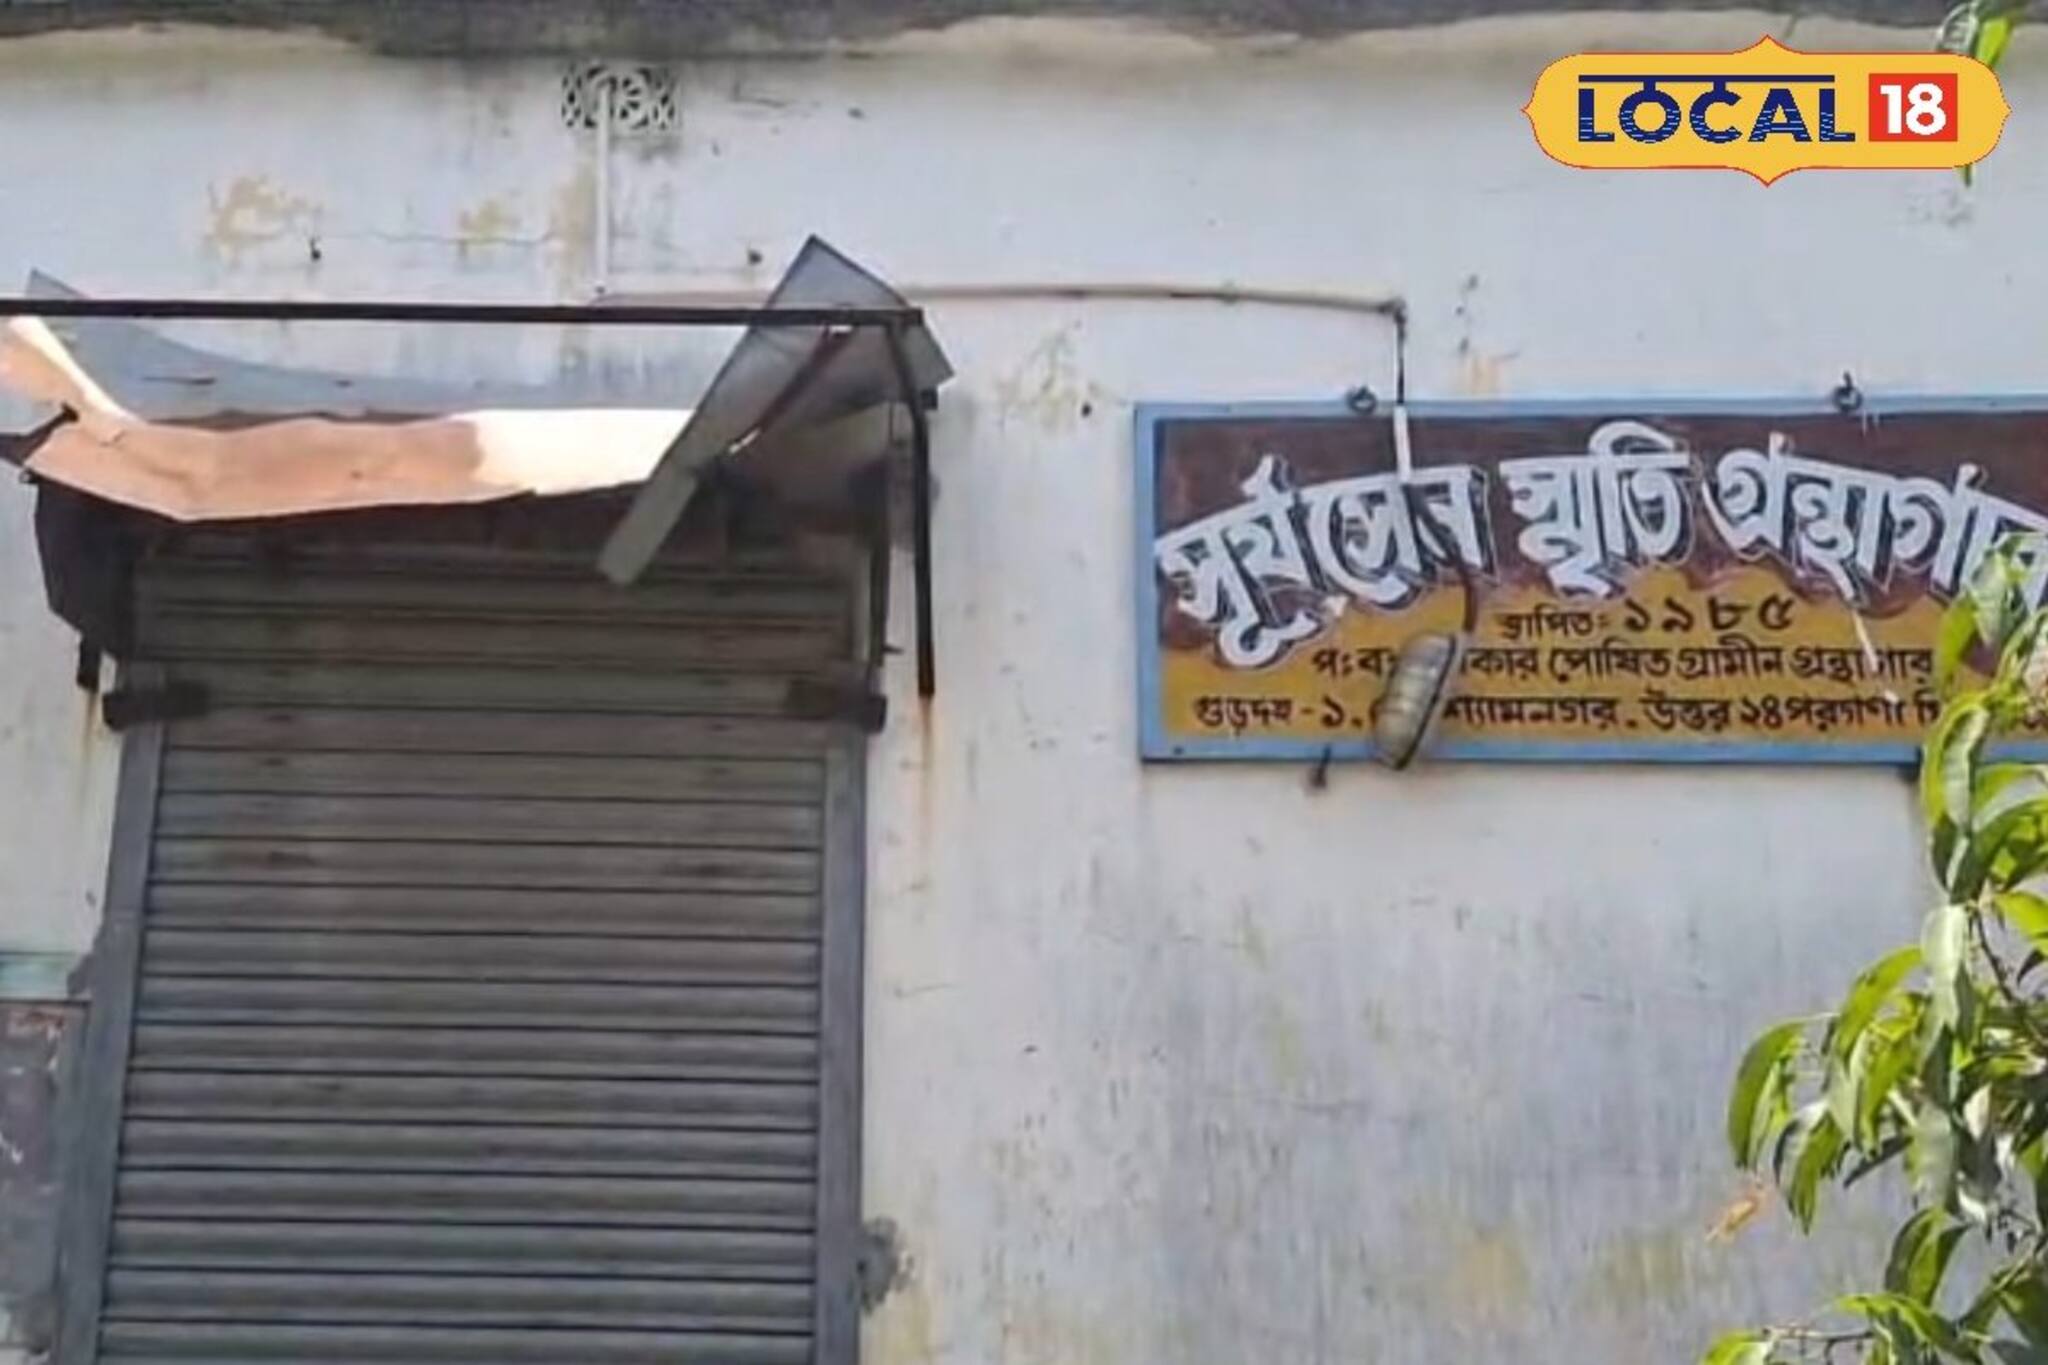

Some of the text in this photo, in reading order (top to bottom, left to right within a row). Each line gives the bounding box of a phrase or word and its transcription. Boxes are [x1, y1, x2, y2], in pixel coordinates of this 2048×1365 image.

[1499, 420, 1692, 598] স্মৃতি
[1624, 596, 1794, 633] ১৯৮৫
[1550, 637, 1671, 682] পোষিত
[1639, 687, 1730, 732] উত্তর
